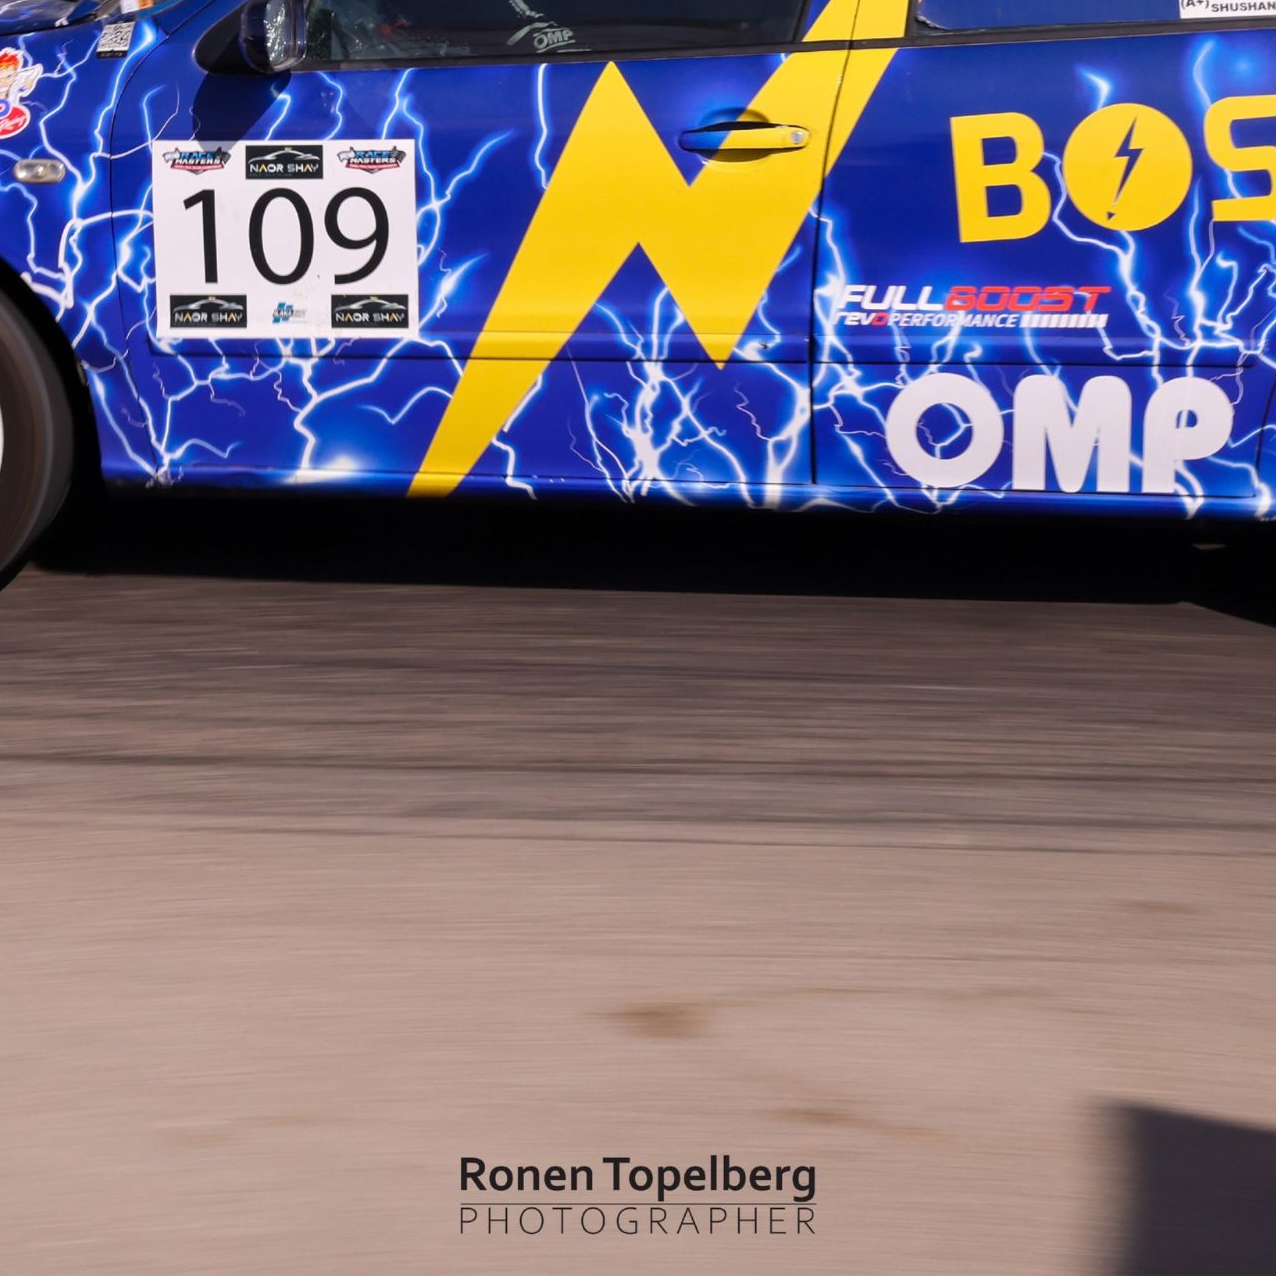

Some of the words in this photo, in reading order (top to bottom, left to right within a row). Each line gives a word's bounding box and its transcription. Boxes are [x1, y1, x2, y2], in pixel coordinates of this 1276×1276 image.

[1210, 1, 1276, 13] SHUSHAN
[533, 29, 574, 49] OMP
[249, 163, 284, 173] NAOR
[287, 163, 319, 173] SHAY
[182, 186, 389, 285] 109
[174, 312, 208, 323] NAOR
[211, 312, 243, 323] SHAY
[335, 312, 370, 323] NAOR
[372, 312, 405, 323] SHAY
[885, 372, 1234, 494] OMP
